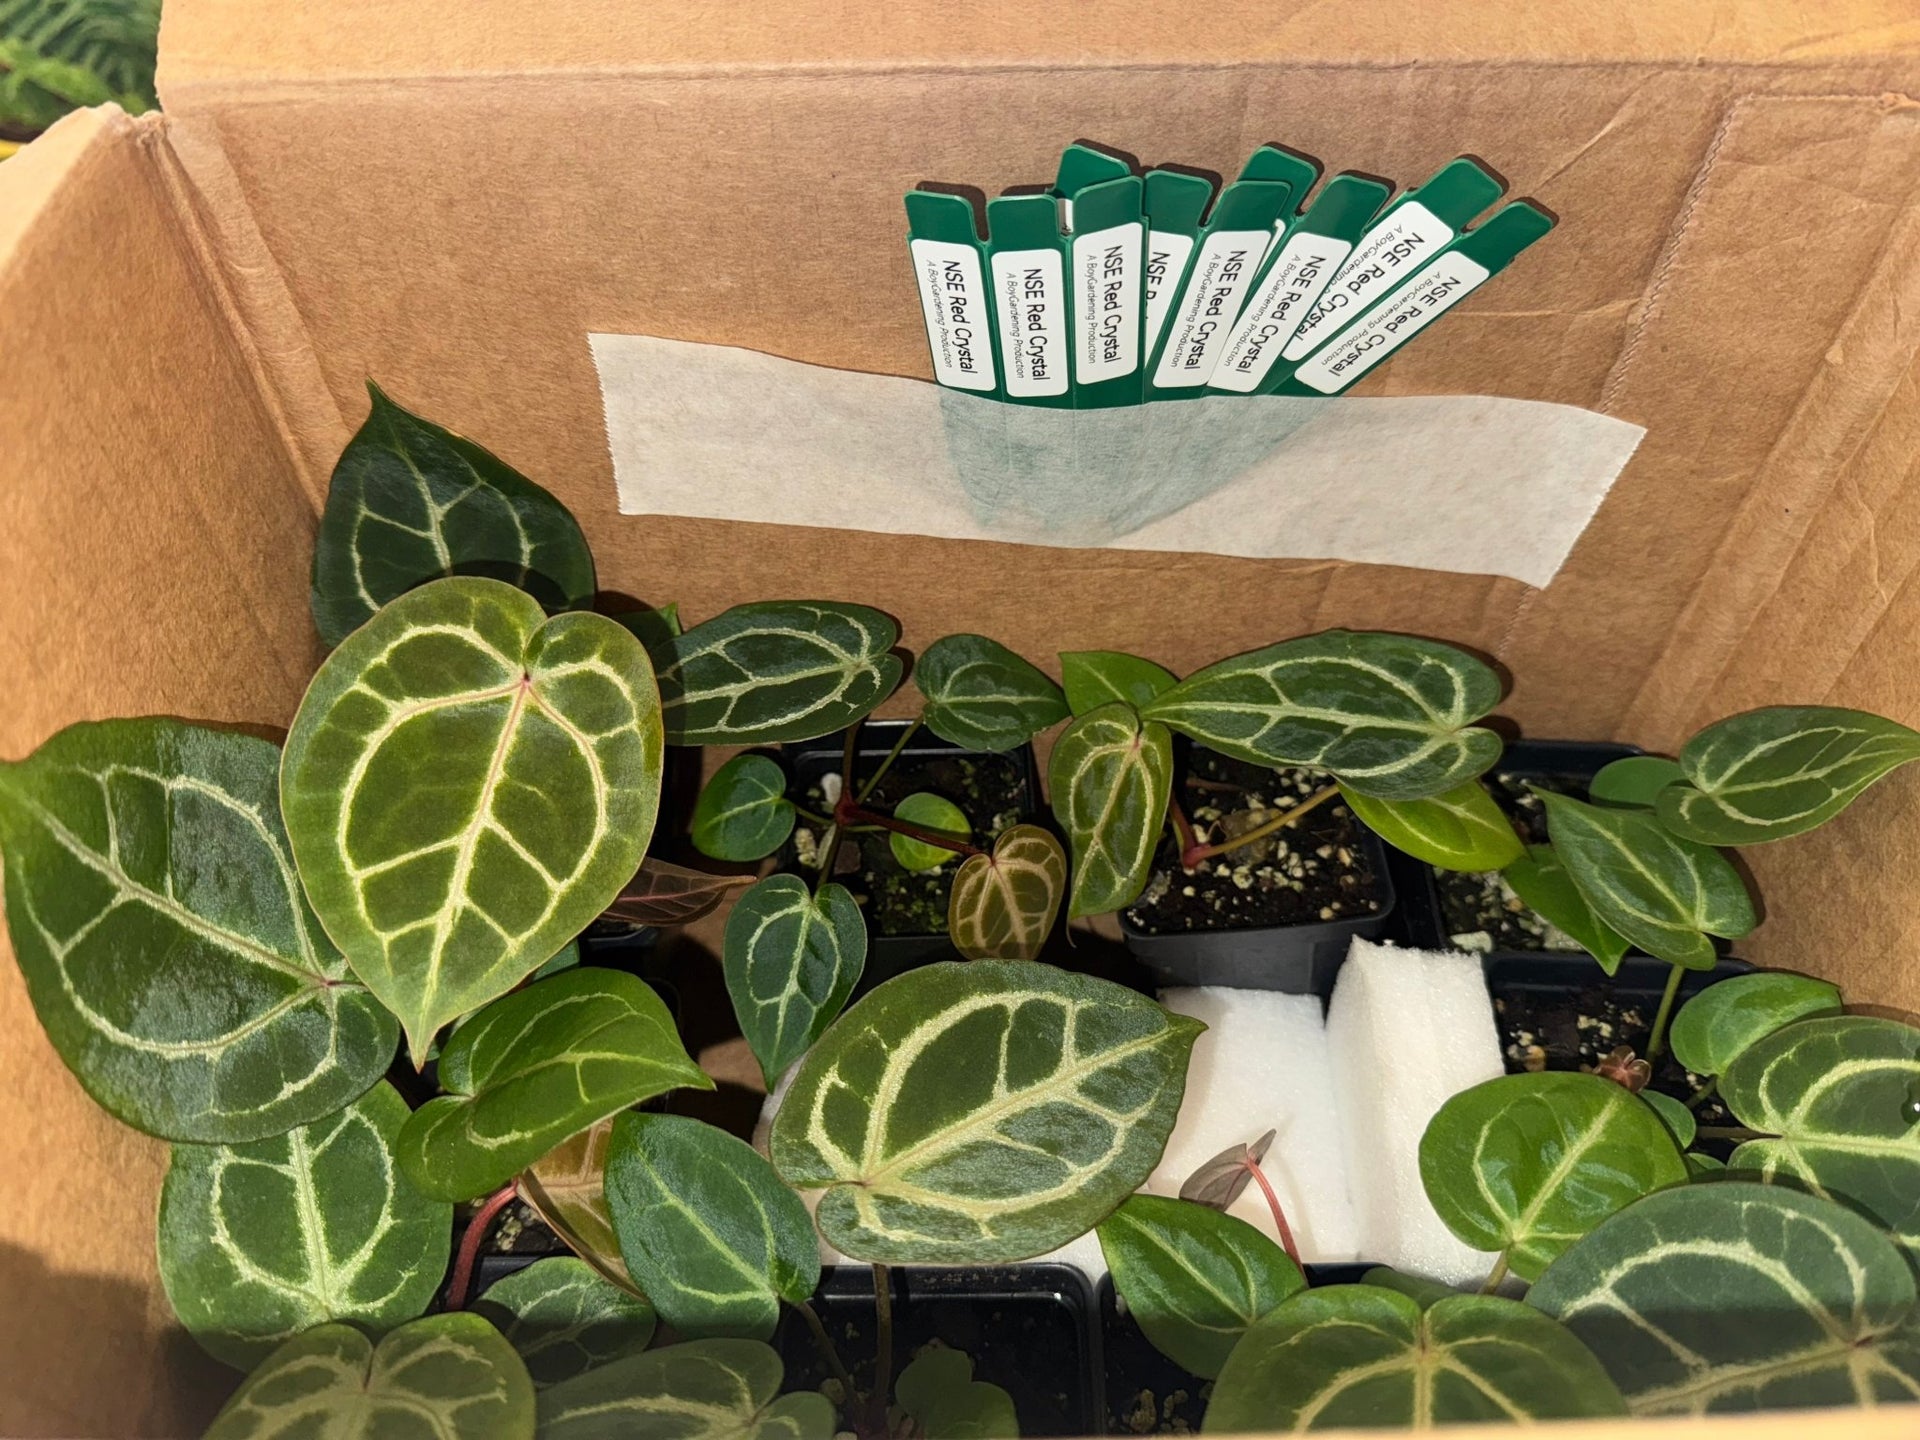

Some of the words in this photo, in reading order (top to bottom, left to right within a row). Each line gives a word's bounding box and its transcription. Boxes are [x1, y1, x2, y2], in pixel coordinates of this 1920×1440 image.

[1394, 224, 1403, 234] A
[926, 259, 936, 267] A
[1104, 245, 1123, 279] NSE
[1211, 253, 1221, 261] A
[1219, 250, 1248, 283] NSE
[1291, 254, 1301, 262] A
[1381, 232, 1425, 267] NSE
[943, 260, 966, 292] NSE
[1023, 268, 1044, 299] NSE
[1291, 255, 1326, 289] NSE
[1346, 263, 1386, 295] Red
[1432, 271, 1441, 279] A
[927, 268, 945, 326] BoyGardening
[1084, 263, 1098, 322] BoyGardening
[1104, 280, 1123, 312] Red
[1185, 261, 1219, 322] BoyGardening
[1205, 287, 1232, 317] Red
[1251, 262, 1297, 322] BoyGardening
[1270, 291, 1302, 321] Red
[1367, 278, 1434, 329] BoyGardening
[1419, 276, 1461, 307] NSE
[949, 295, 971, 324] Red
[1026, 304, 1047, 331] Red
[1294, 293, 1349, 342] Crystal
[1384, 306, 1423, 334] Red
[941, 325, 952, 368] Production
[1005, 281, 1020, 338] BoyGardening
[1013, 339, 1024, 379] Production
[1088, 323, 1098, 364] Production
[1099, 314, 1122, 363] Crystal
[1170, 324, 1195, 368] Production
[1184, 321, 1217, 370] Crystal
[1224, 323, 1257, 367] Production
[952, 328, 978, 374] Crystal
[1026, 336, 1051, 380] Crystal
[1235, 324, 1279, 374] Crystal
[1320, 330, 1369, 366] Production
[1328, 334, 1386, 377] Crystal
